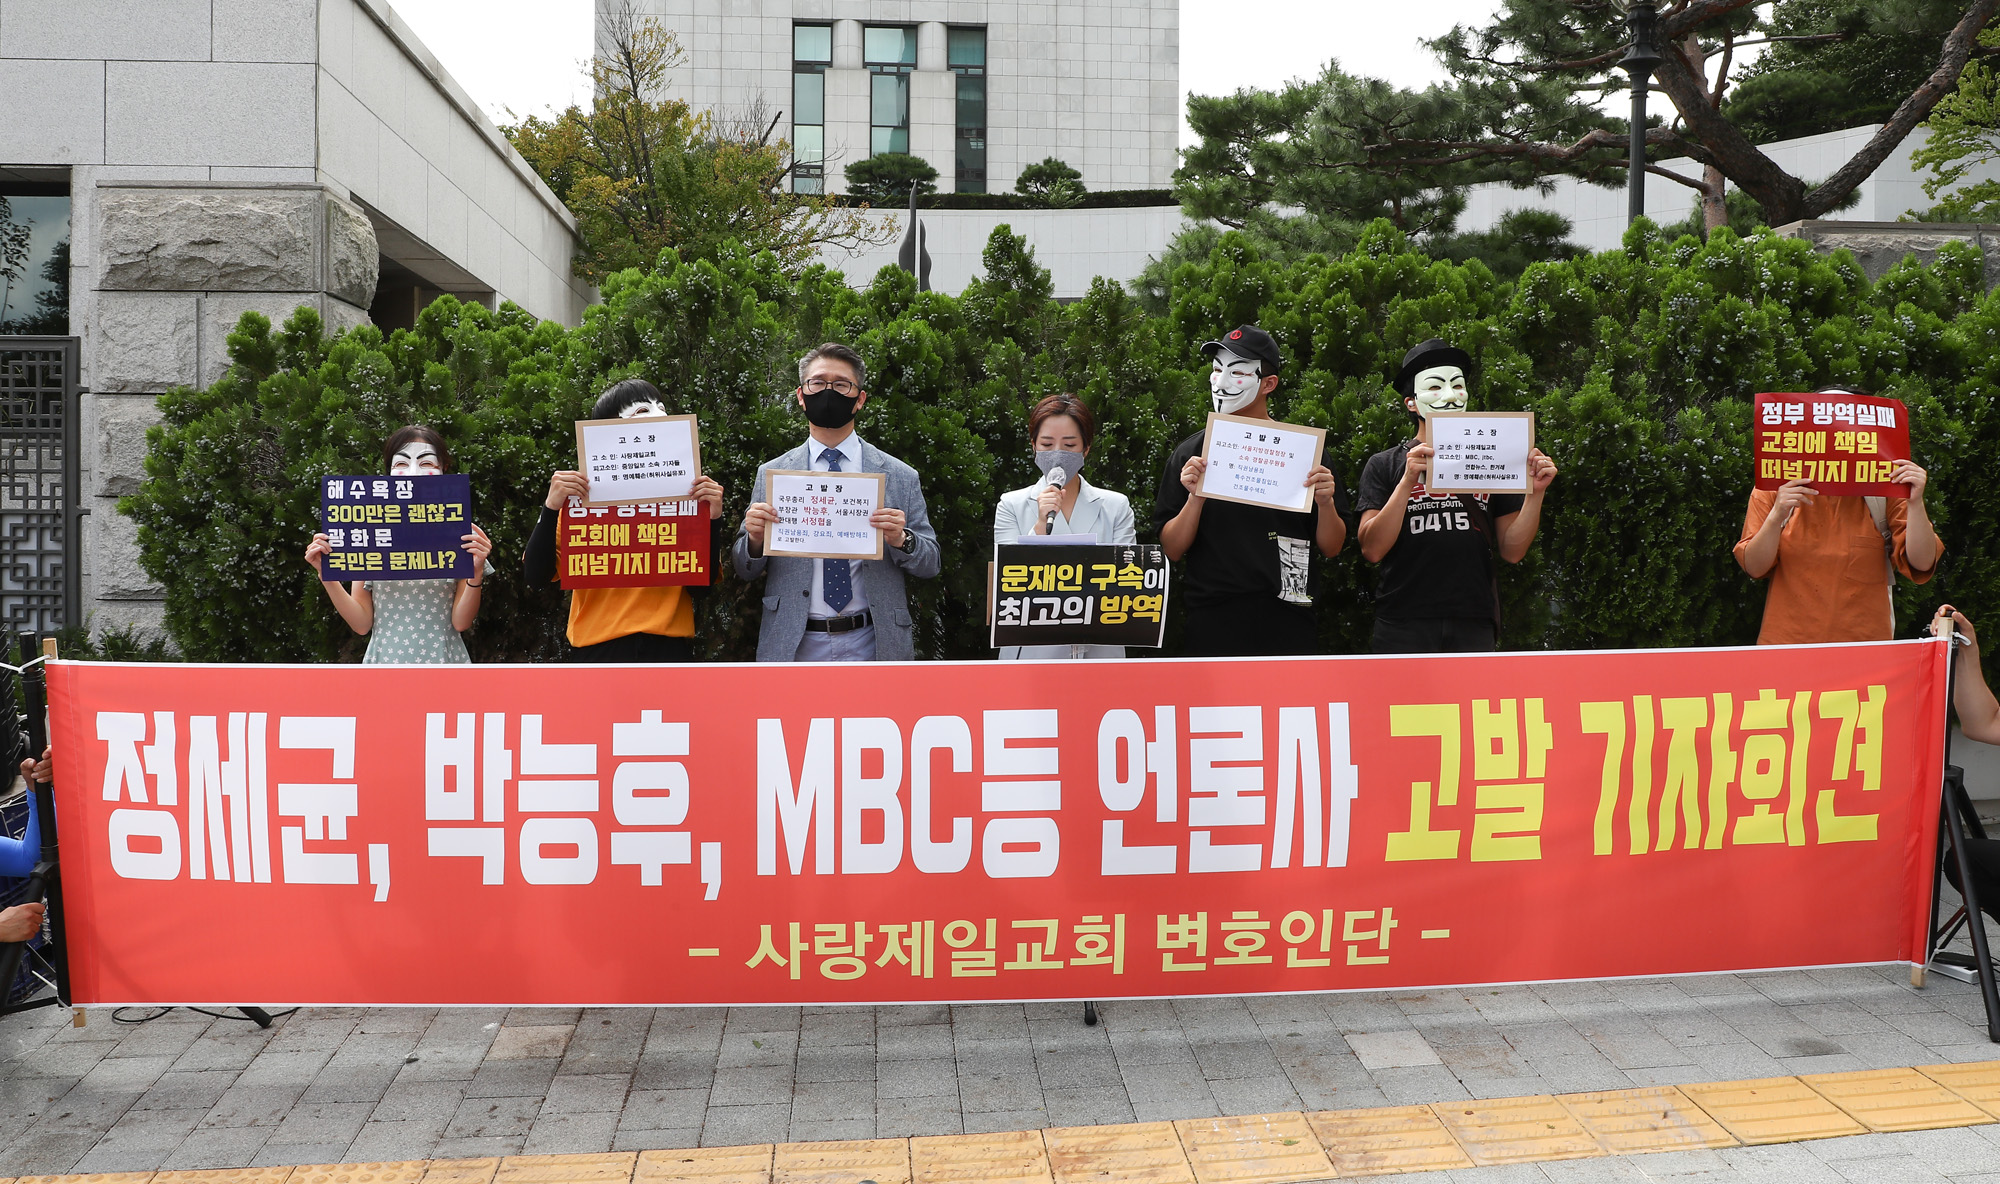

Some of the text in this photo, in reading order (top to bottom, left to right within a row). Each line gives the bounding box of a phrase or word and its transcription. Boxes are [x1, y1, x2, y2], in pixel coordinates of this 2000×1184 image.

[1762, 402, 1896, 429] 정부 방역실패
[1216, 441, 1240, 450] 피고소인:
[1761, 431, 1878, 454] 교회에 책임
[621, 451, 656, 459] 사랑제일교회
[593, 464, 619, 472] 피고소인:
[622, 462, 646, 470] 중앙일보
[1761, 459, 1847, 483] 떠넘기지
[779, 495, 869, 506] 국무총리 정세균, 보건복지
[779, 506, 798, 514] 부장관
[835, 508, 869, 516] 서울시장권
[1408, 501, 1440, 512] PROTECT
[328, 503, 464, 523] 300만은 괜찮고
[1410, 512, 1470, 535] 0415
[569, 523, 677, 547] 교회에 책임
[329, 551, 457, 571] 국민은 문제냐?
[569, 551, 704, 576] 떠넘기지 마라.
[1001, 563, 1165, 592] 문재인 구속이
[998, 594, 1163, 626] 최고의 방역
[96, 685, 1887, 902] 정세균, 박능후, MBC등 언론사 고발 기자회견
[745, 913, 1126, 981] 사랑제일교회
[1156, 907, 1399, 973] 변호인단
